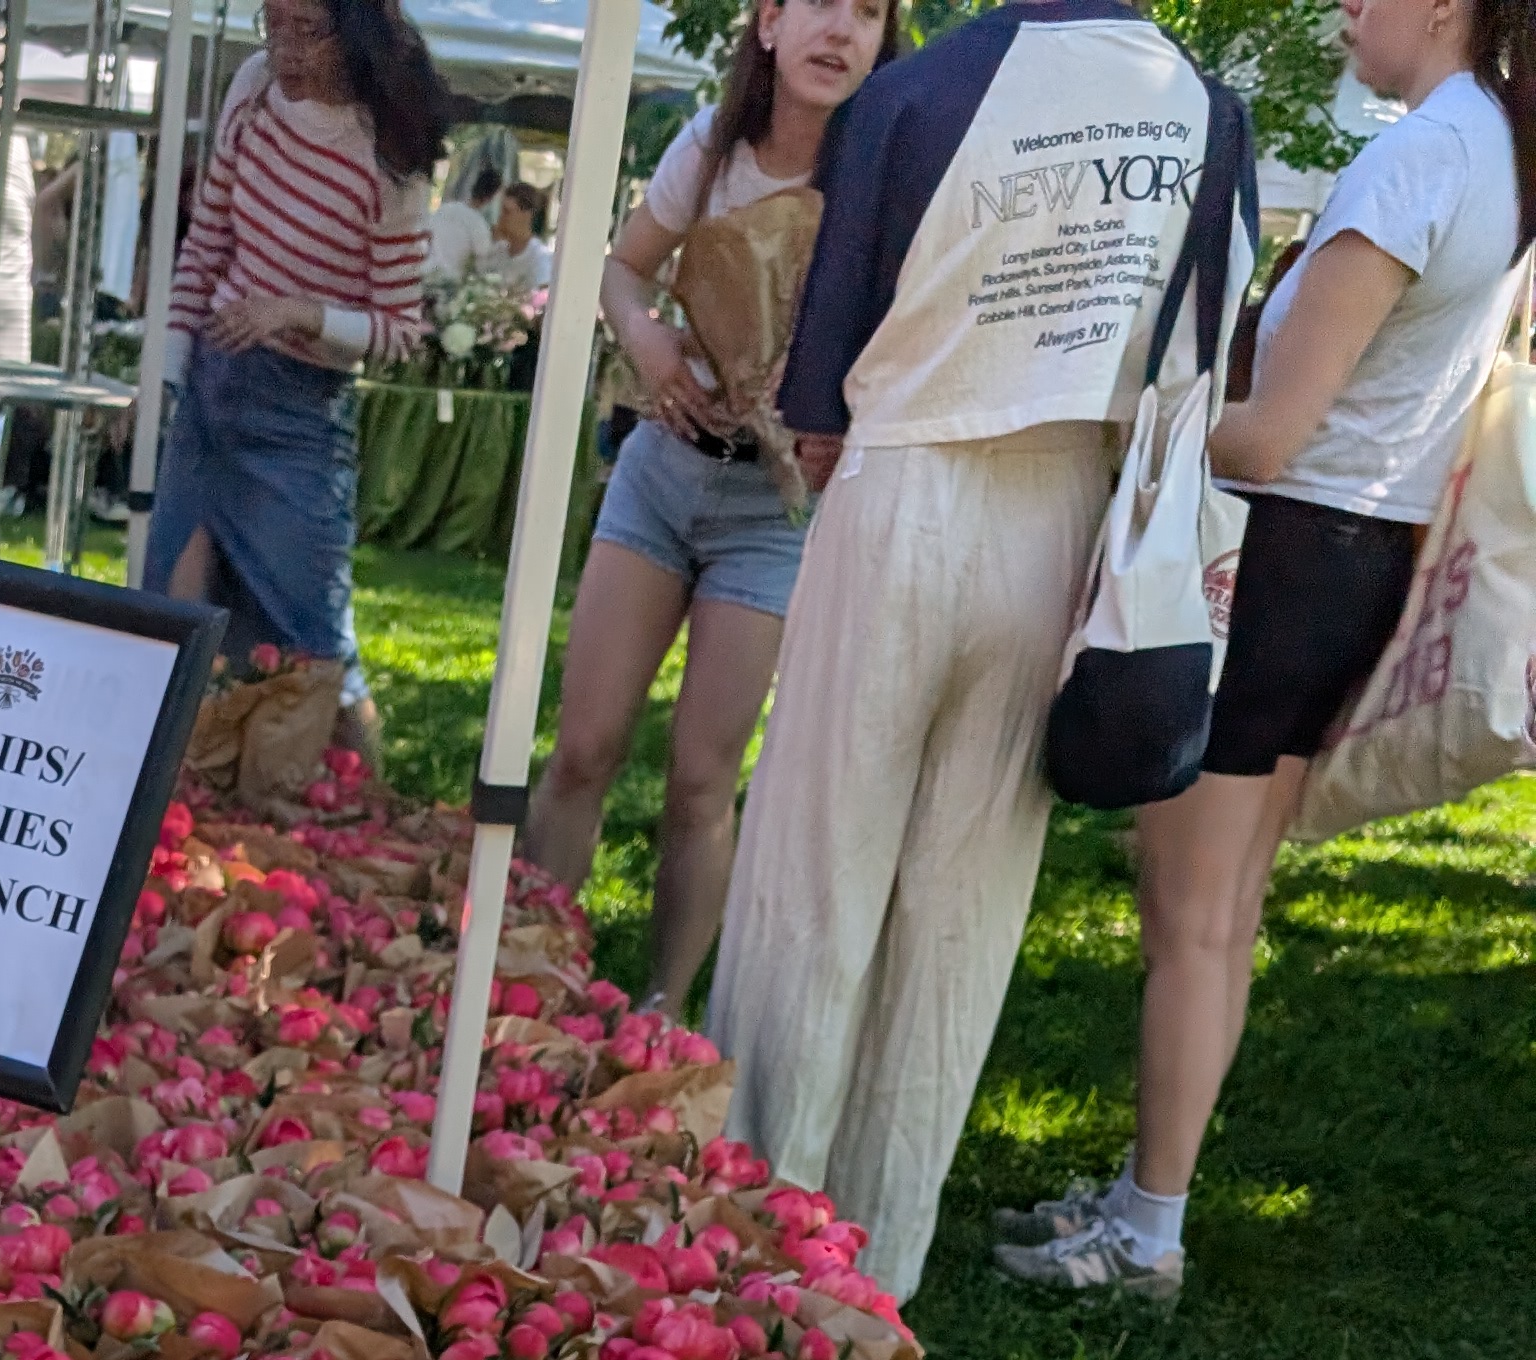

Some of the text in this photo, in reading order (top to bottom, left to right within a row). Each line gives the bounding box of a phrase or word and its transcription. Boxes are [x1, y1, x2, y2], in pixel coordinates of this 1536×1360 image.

[1013, 120, 1191, 155] Welcome To The Big City
[970, 154, 1204, 229] NEW YORK
[1034, 325, 1086, 349] Always
